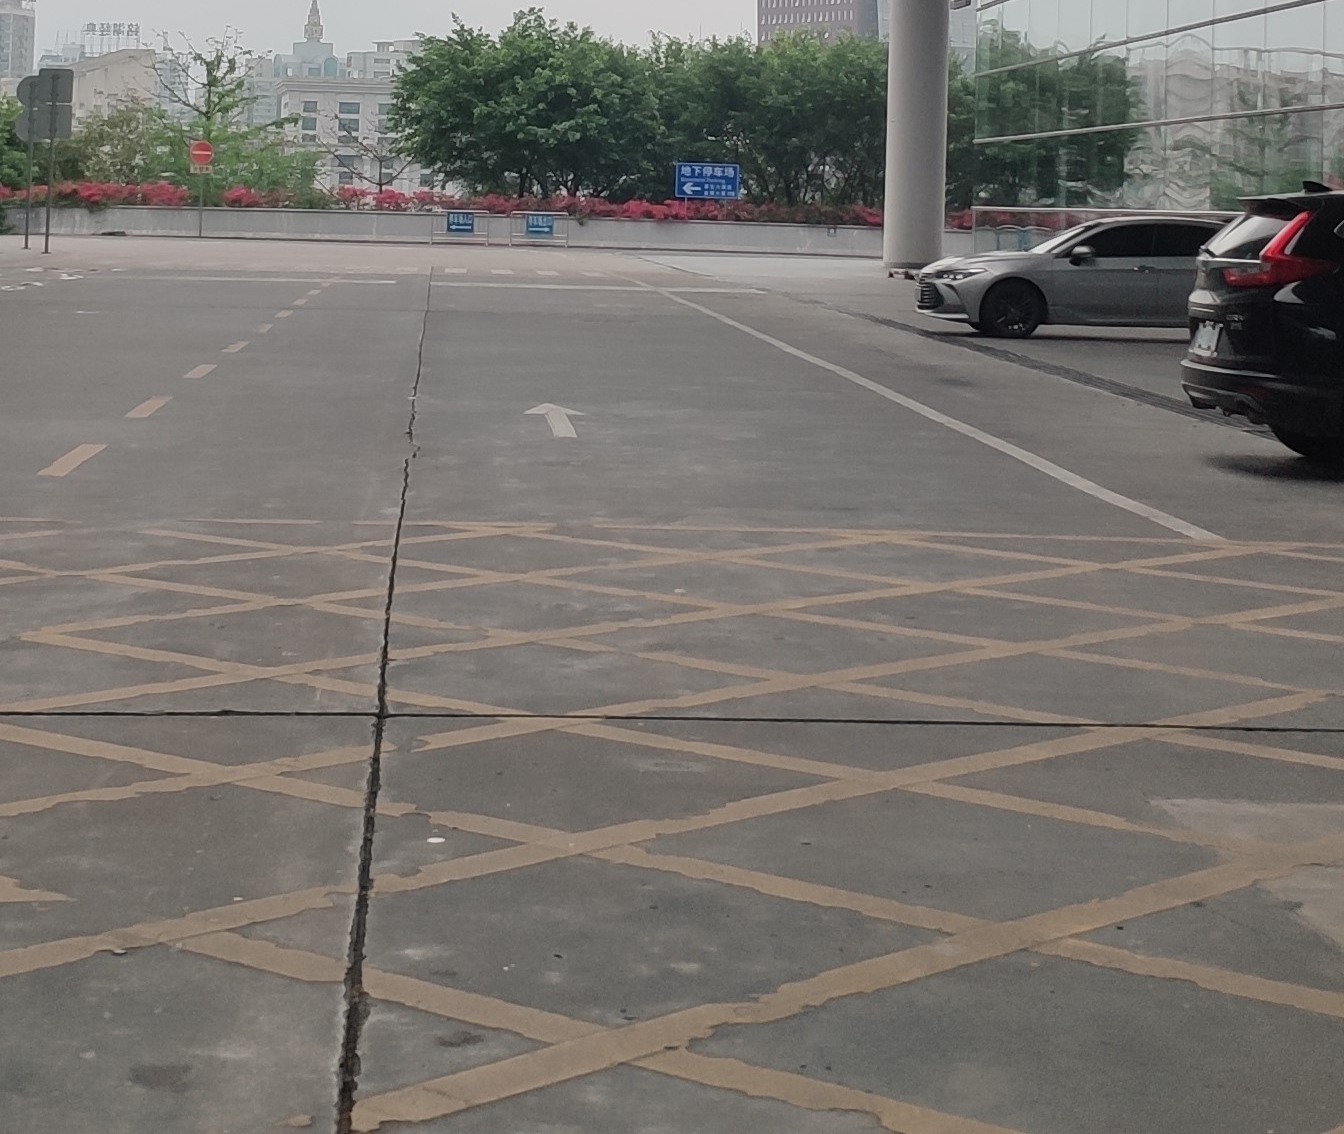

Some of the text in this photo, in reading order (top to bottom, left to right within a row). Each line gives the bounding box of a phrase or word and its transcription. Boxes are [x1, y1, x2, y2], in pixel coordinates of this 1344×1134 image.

[681, 166, 735, 178] 地下停车场
